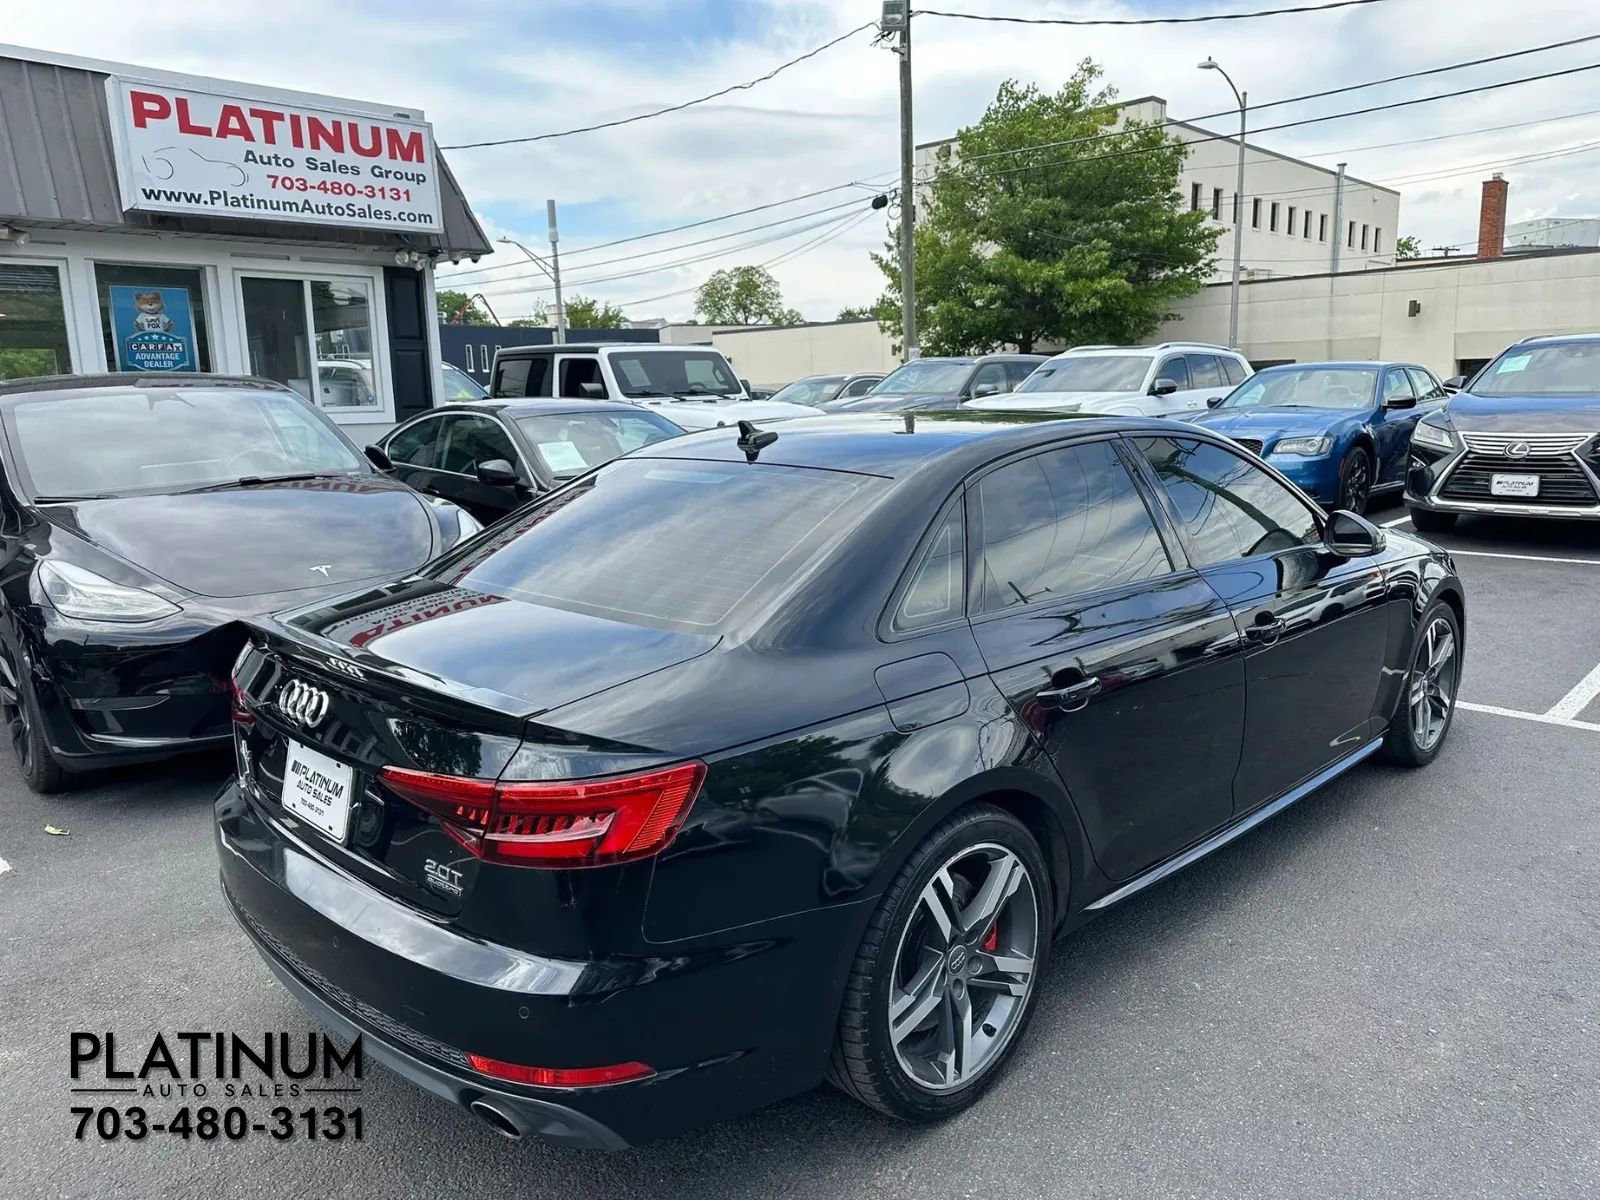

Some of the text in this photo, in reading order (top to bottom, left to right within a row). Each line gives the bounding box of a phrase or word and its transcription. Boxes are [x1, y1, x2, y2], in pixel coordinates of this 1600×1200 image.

[130, 91, 425, 163] PLATINUM
[244, 150, 426, 185] Auto Sales Group
[266, 175, 411, 202] 703-480-3131
[141, 188, 433, 224] www.PlatinumAutoSales.com
[130, 343, 182, 352] CARFAX
[135, 353, 180, 361] ADVANTAGE
[296, 779, 333, 807] AUTO SALES
[300, 765, 344, 798] PLATINUM
